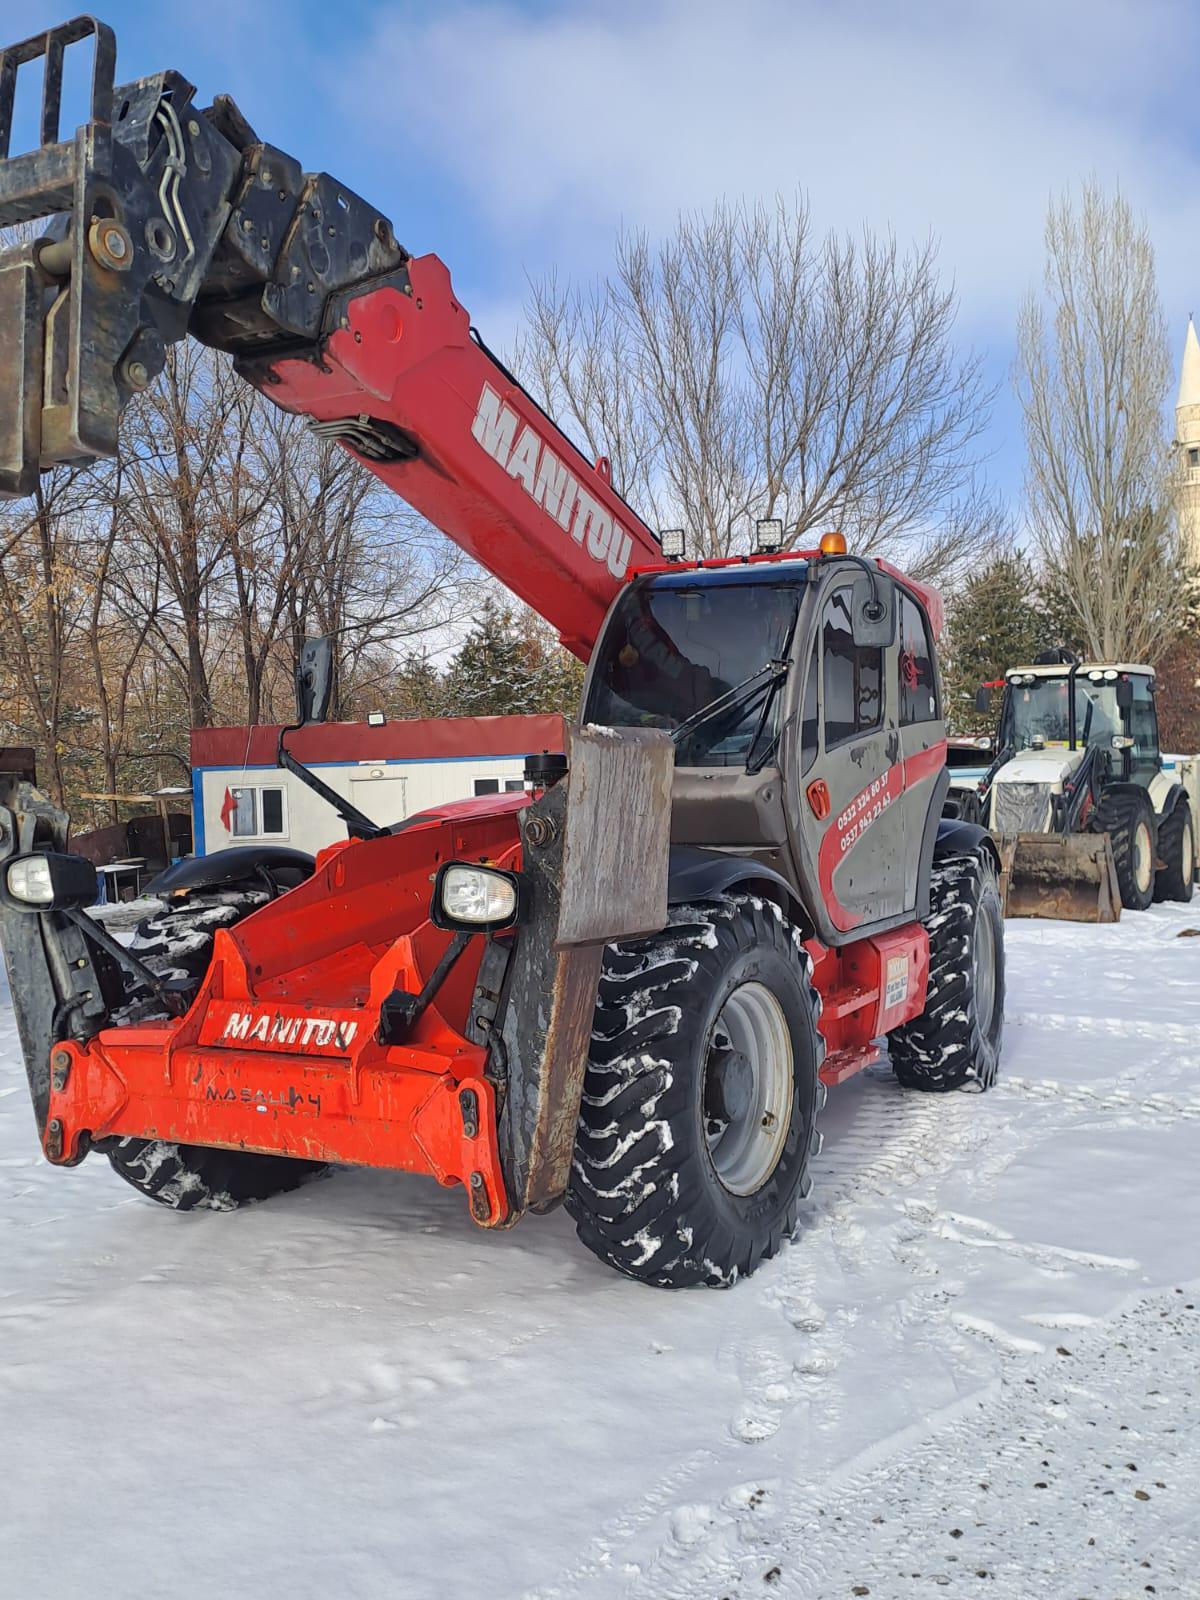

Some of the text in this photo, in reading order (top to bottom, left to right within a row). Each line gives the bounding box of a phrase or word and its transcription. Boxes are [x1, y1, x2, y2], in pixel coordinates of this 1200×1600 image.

[471, 380, 633, 580] MANITOU
[838, 805, 856, 830] 0532
[871, 780, 880, 797] 80
[881, 771, 889, 787] 37
[841, 824, 857, 851] 0537
[223, 1012, 358, 1050] MANITOU
